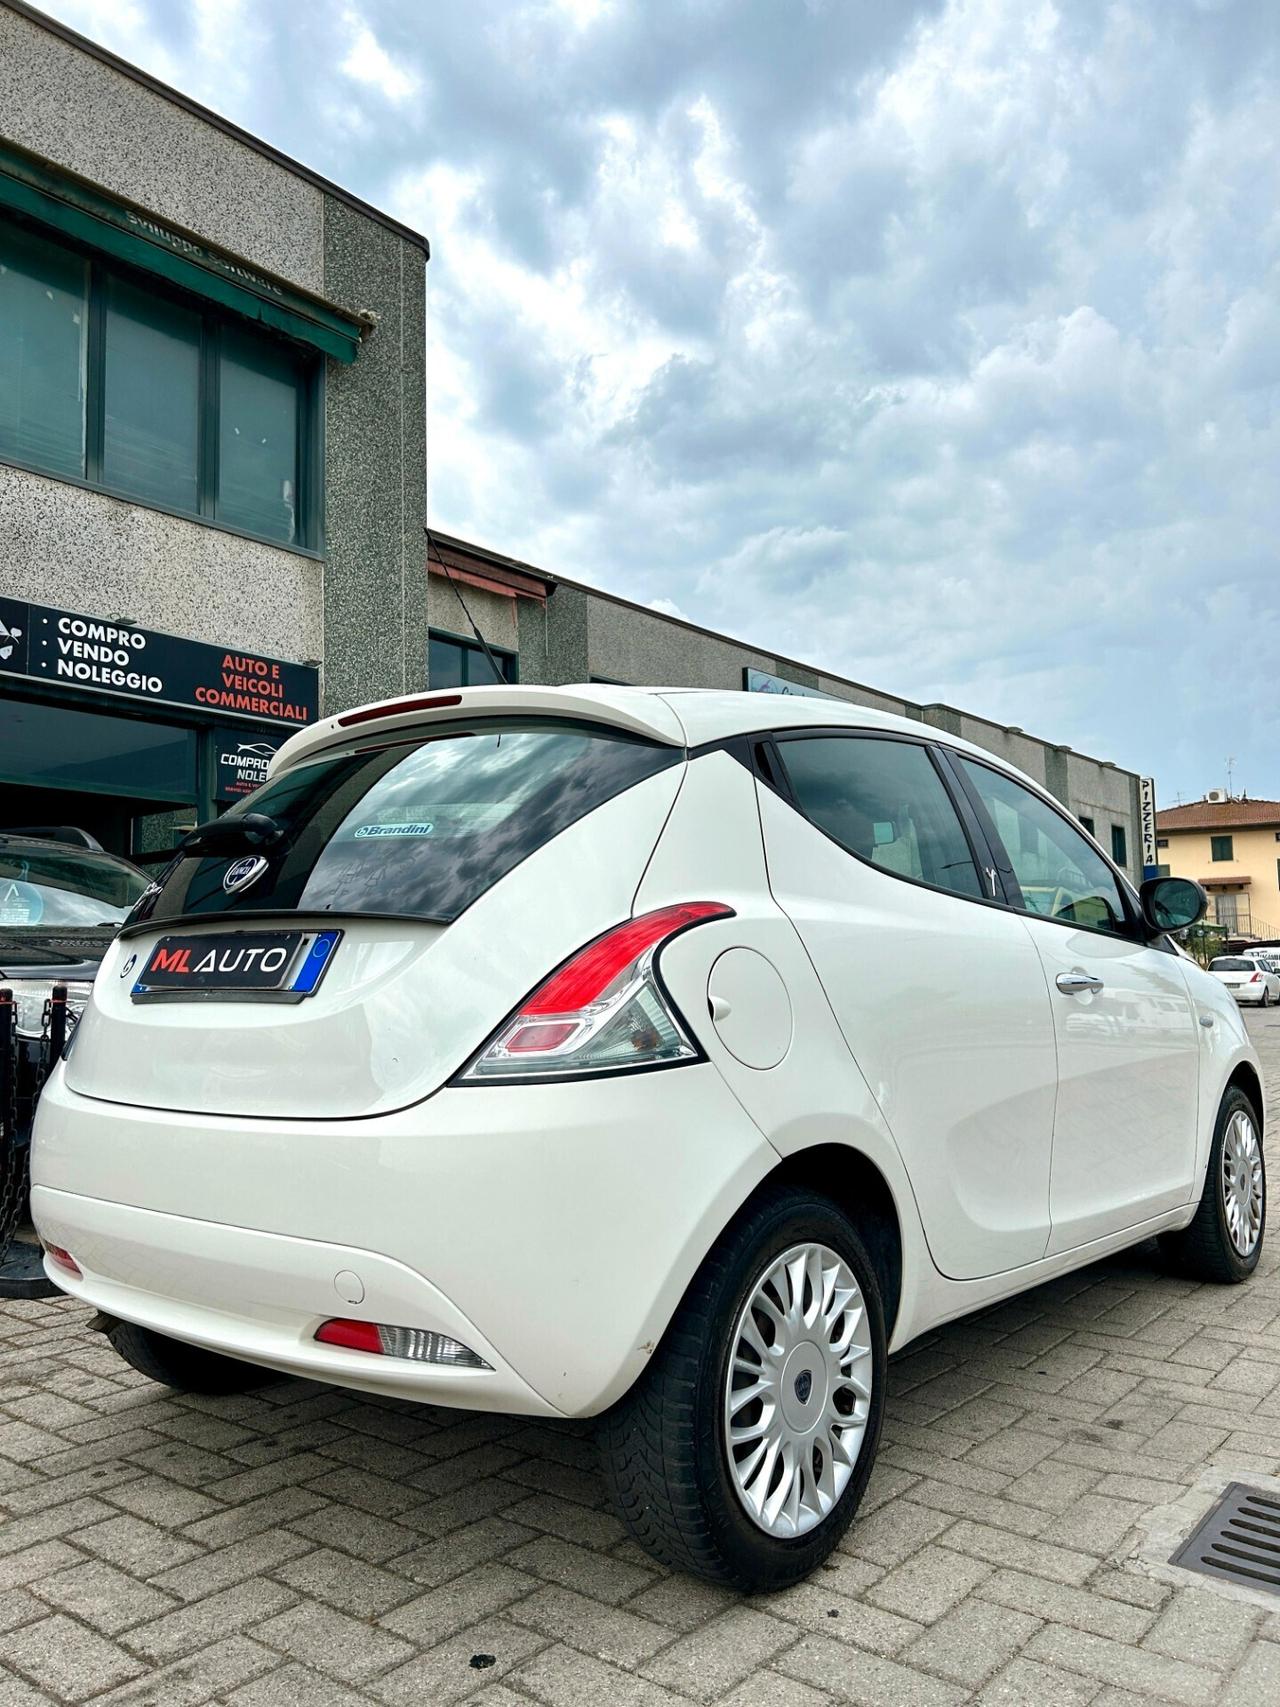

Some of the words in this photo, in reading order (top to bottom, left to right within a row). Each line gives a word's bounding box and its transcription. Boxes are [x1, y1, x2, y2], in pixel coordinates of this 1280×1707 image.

[57, 617, 147, 650] COMPRO
[57, 637, 130, 667] VENDO
[57, 659, 163, 693] NOLEGGIO
[222, 654, 268, 677] AUTO
[272, 664, 280, 679] E
[221, 671, 283, 698] VEICOLI
[195, 686, 308, 721] COMMERCIALI
[220, 753, 270, 770] COMPRO
[367, 824, 431, 836] Brandini
[1142, 780, 1153, 865] PIZZERIA
[193, 947, 287, 973] AUTO
